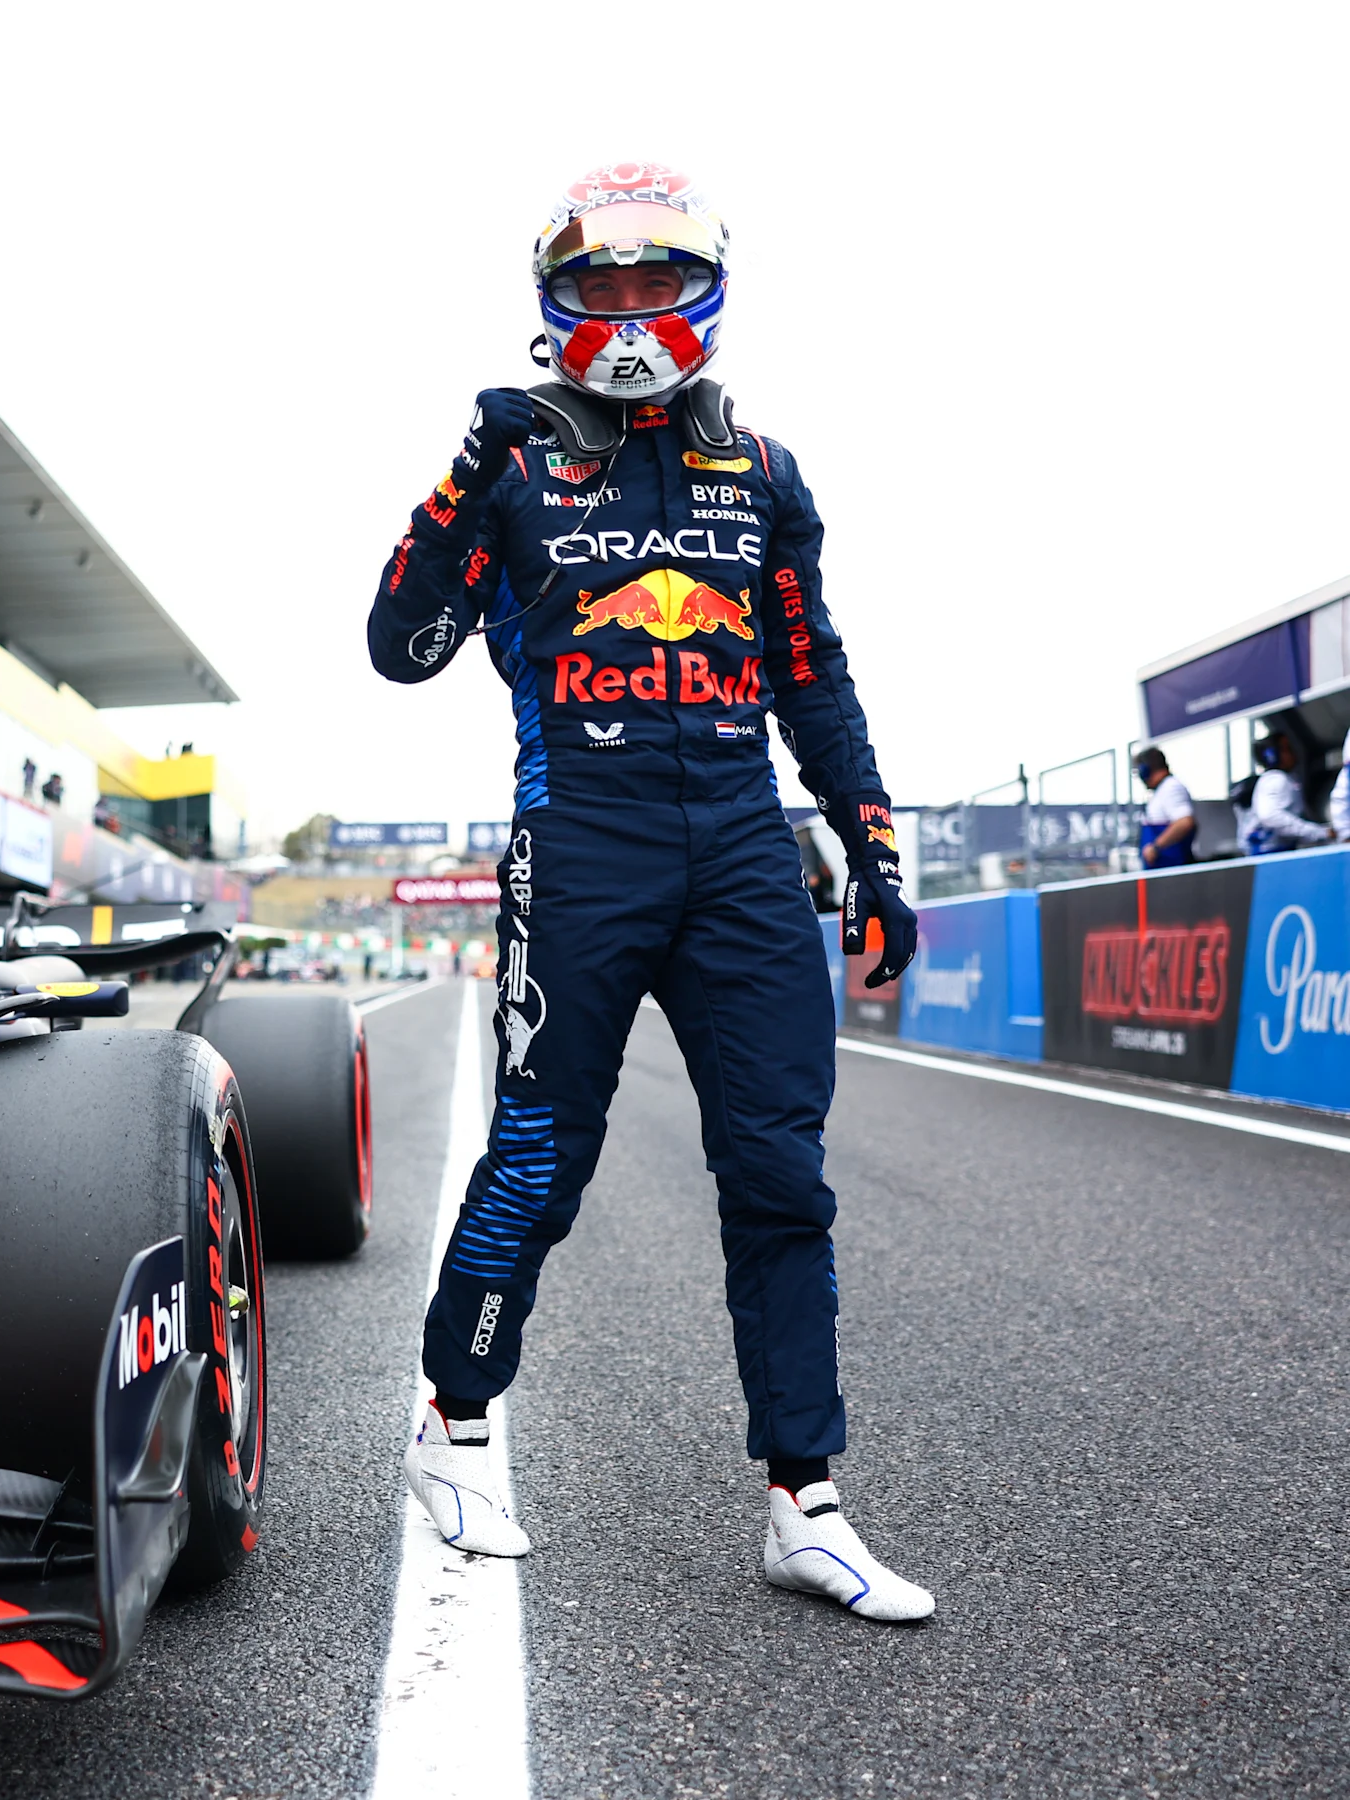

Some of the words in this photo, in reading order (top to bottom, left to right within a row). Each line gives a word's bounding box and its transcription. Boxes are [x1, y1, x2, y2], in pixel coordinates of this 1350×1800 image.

[570, 190, 687, 218] ORACLE
[611, 356, 656, 379] EA
[682, 353, 703, 376] BYBIT
[610, 376, 656, 390] SPORTS
[632, 417, 652, 430] Red
[651, 415, 669, 427] Bull
[550, 453, 581, 467] TA
[550, 461, 600, 482] HEUER
[542, 490, 599, 508] Mobil
[691, 484, 752, 507] BYBIT
[423, 493, 457, 528] Bull
[691, 509, 761, 526] HONDA
[548, 528, 762, 568] ORACLE
[773, 567, 803, 618] GIVES
[435, 606, 454, 642] ard
[554, 646, 668, 704] Red
[678, 650, 763, 706] Bull
[846, 881, 860, 921] sparco
[118, 1281, 187, 1390] Mobil
